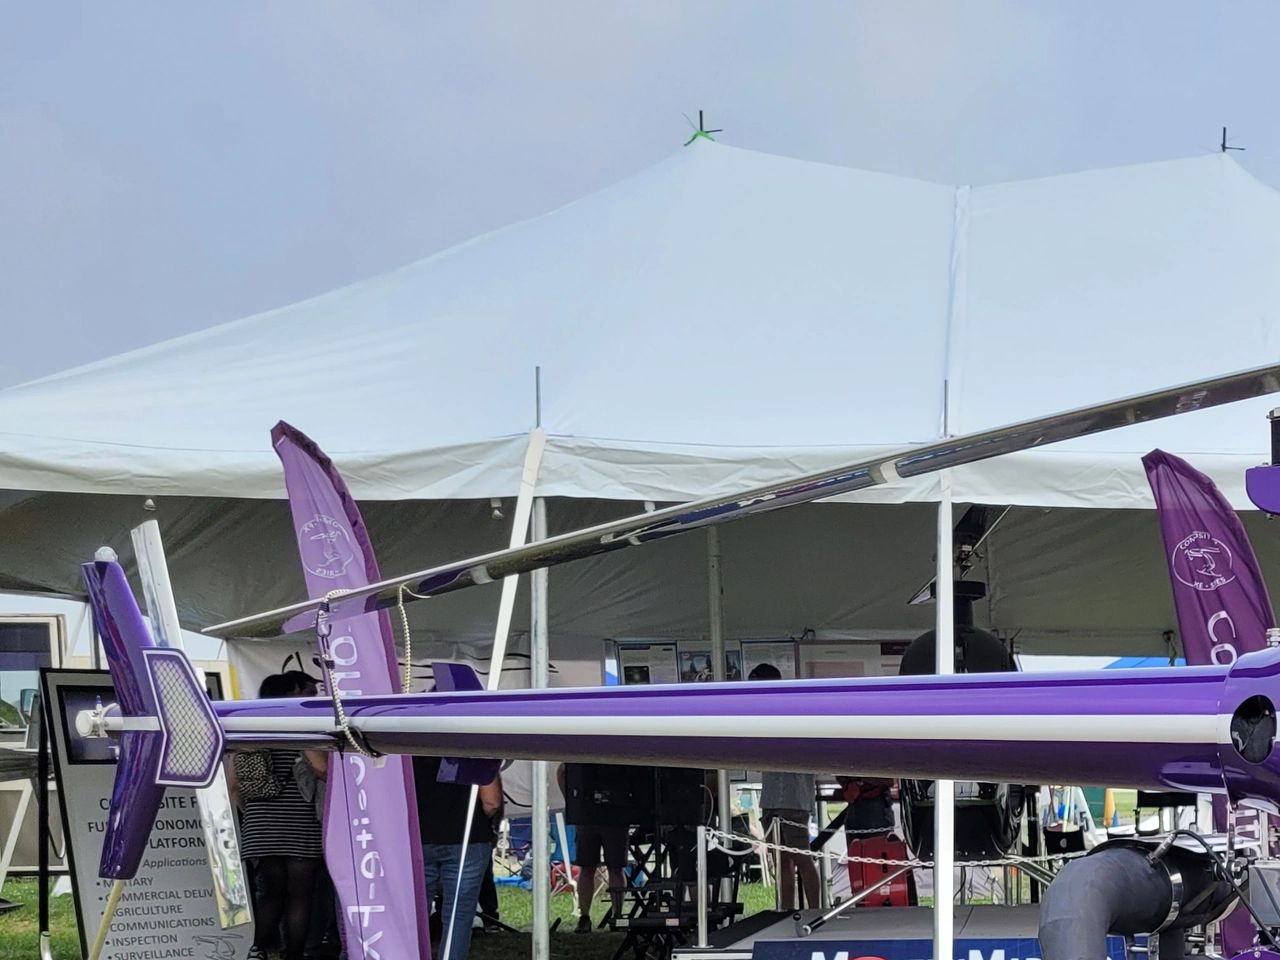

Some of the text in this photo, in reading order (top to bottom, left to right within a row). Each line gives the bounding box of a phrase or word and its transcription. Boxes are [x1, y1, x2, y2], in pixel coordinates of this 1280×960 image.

[142, 857, 208, 869] Applications
[105, 887, 214, 902] CMMERCIAL DELIV
[110, 916, 216, 932] COMMUNICATIONS
[112, 934, 178, 947] INSPECTION
